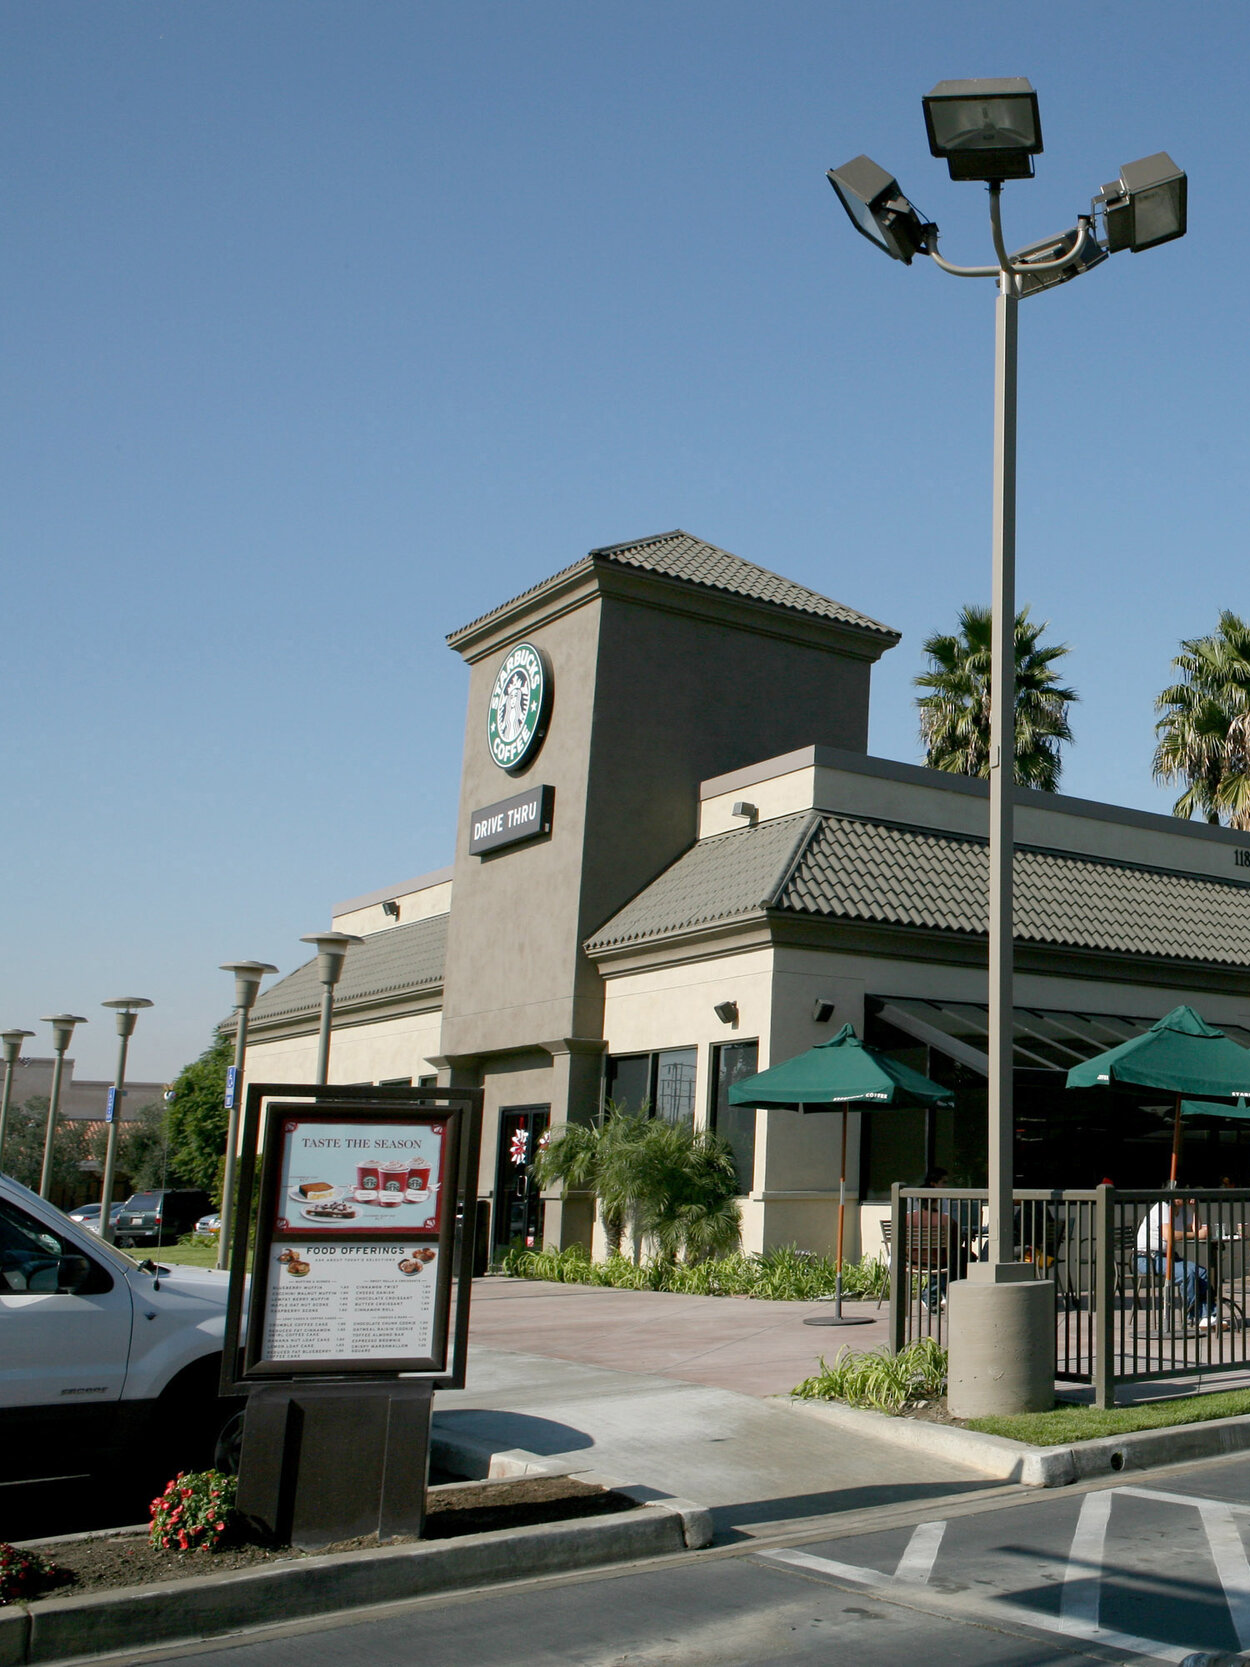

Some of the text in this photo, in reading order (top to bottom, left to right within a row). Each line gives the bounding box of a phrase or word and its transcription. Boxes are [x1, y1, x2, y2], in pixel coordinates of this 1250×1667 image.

[491, 650, 540, 709] STARBUCKS
[494, 725, 530, 761] COFFEE
[474, 801, 537, 841] DRIVE THRU
[302, 1138, 422, 1149] TASTE THE SEASON
[306, 1246, 405, 1255] FOOD OFFERINGS
